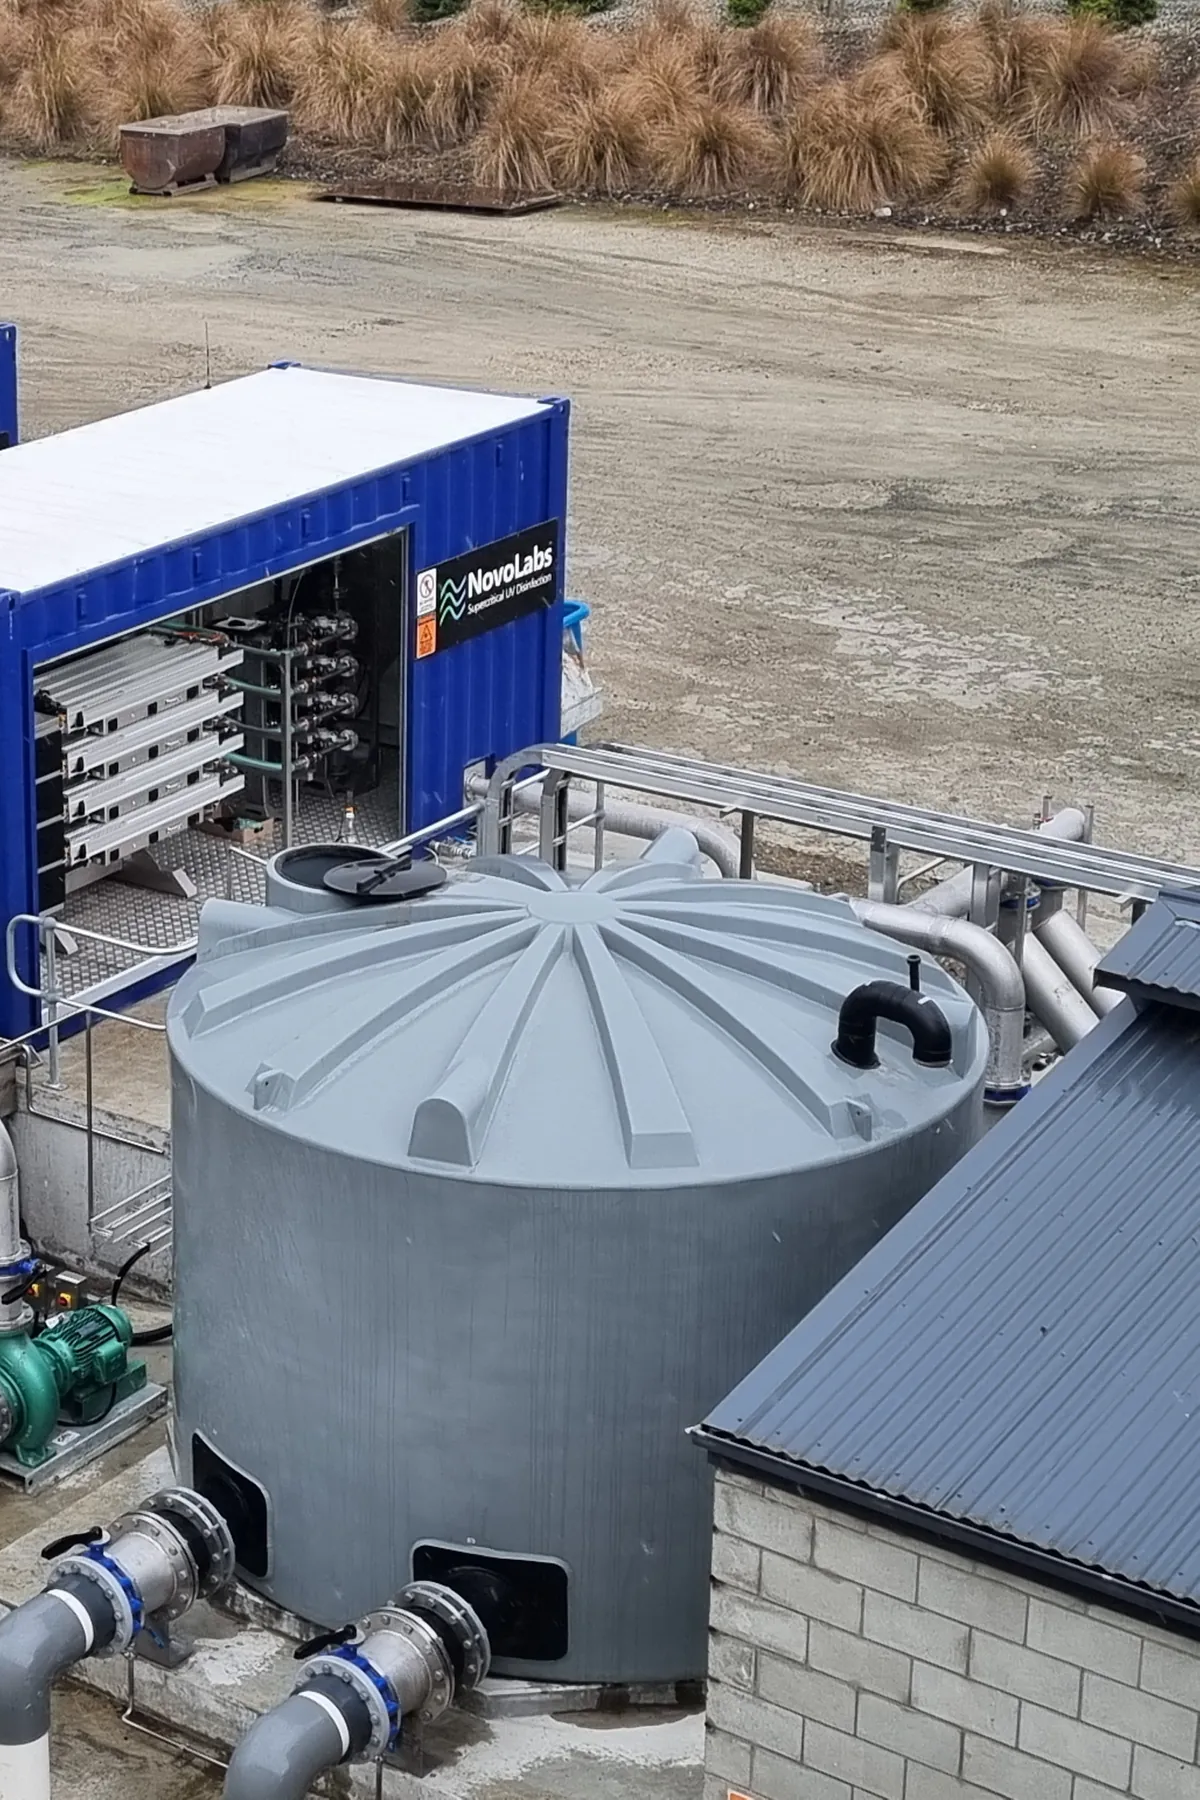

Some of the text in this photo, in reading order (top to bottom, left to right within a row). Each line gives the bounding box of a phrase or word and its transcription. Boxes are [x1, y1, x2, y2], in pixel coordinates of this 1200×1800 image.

[467, 545, 553, 599] NovoLabs
[467, 572, 552, 615] Supercritical UV Disinfection
